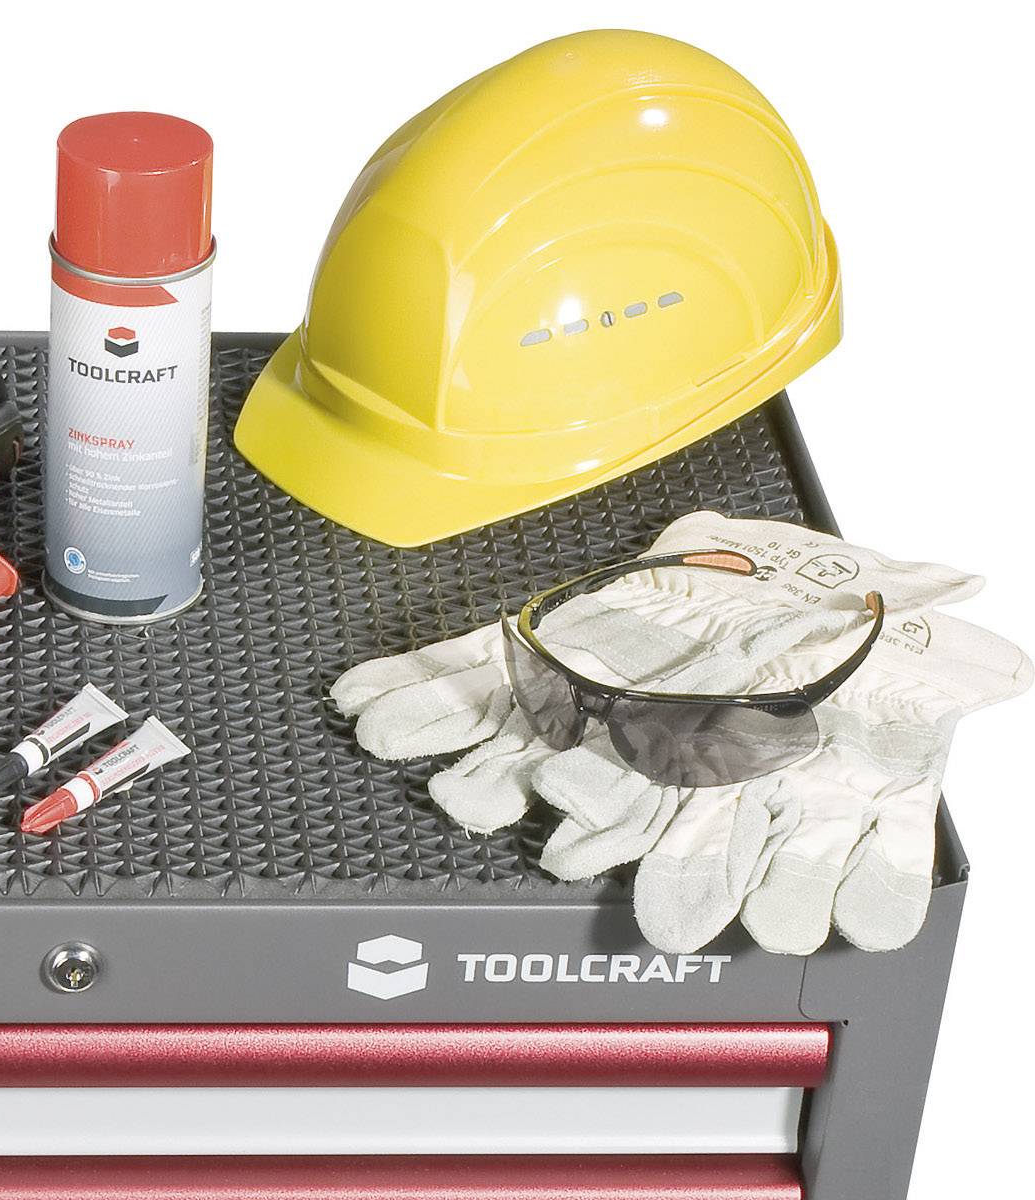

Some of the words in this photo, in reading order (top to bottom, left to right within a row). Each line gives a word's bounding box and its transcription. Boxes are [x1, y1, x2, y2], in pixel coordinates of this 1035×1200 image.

[68, 357, 178, 384] TOOLCRAFT
[68, 427, 135, 449] ZINKSPRAY
[84, 446, 119, 461] hohem
[121, 447, 173, 462] Zinkanteil
[767, 541, 782, 551] 10
[803, 591, 822, 604] EN
[457, 954, 732, 984] TOOLCRAFT
